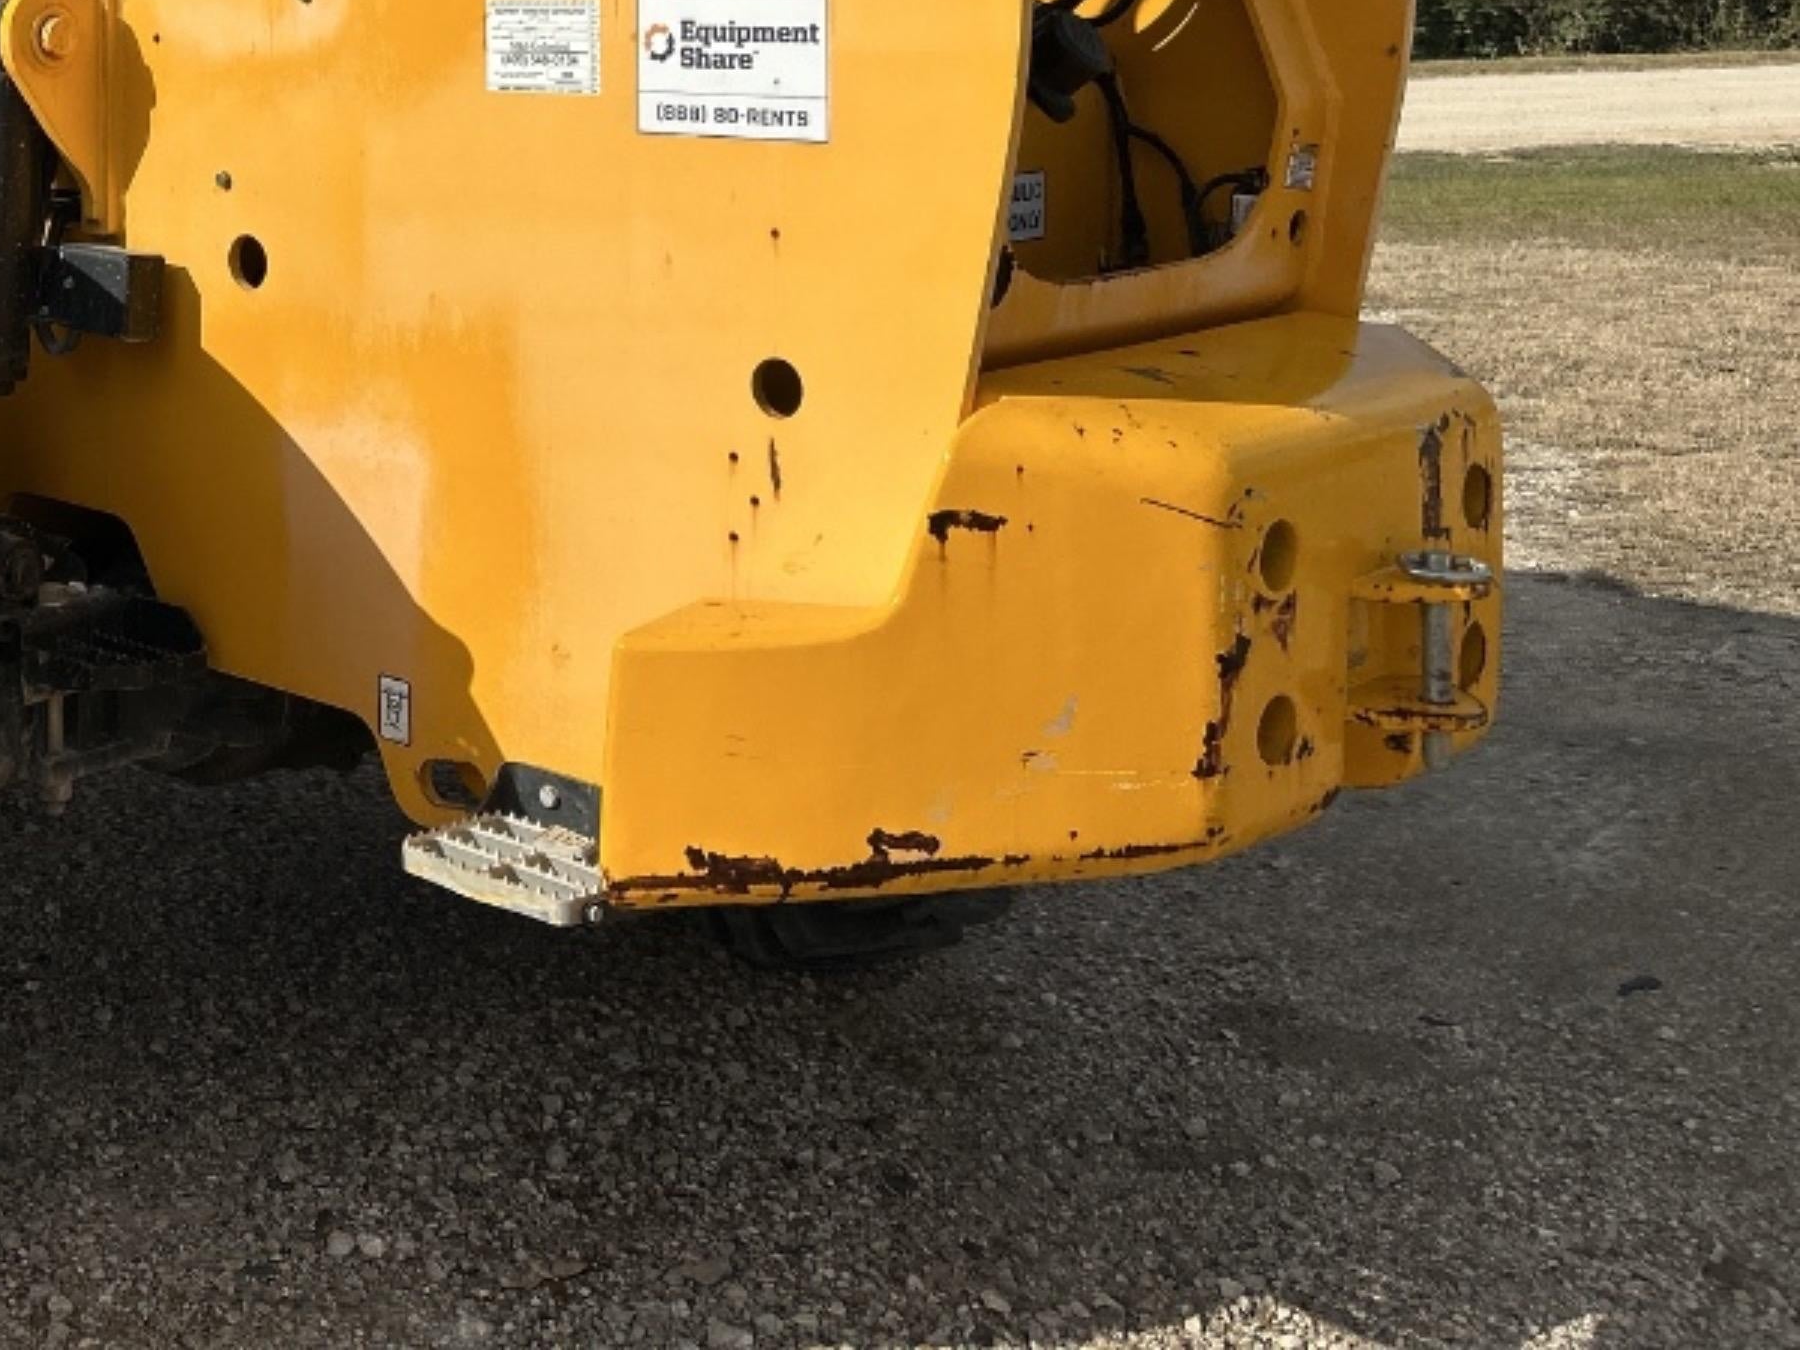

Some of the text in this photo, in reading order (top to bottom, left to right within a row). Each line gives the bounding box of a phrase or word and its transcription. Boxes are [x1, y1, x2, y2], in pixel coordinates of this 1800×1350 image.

[680, 19, 820, 49] Equipment
[680, 47, 754, 70] Share
[656, 103, 809, 128] (888) 80-RENTS
